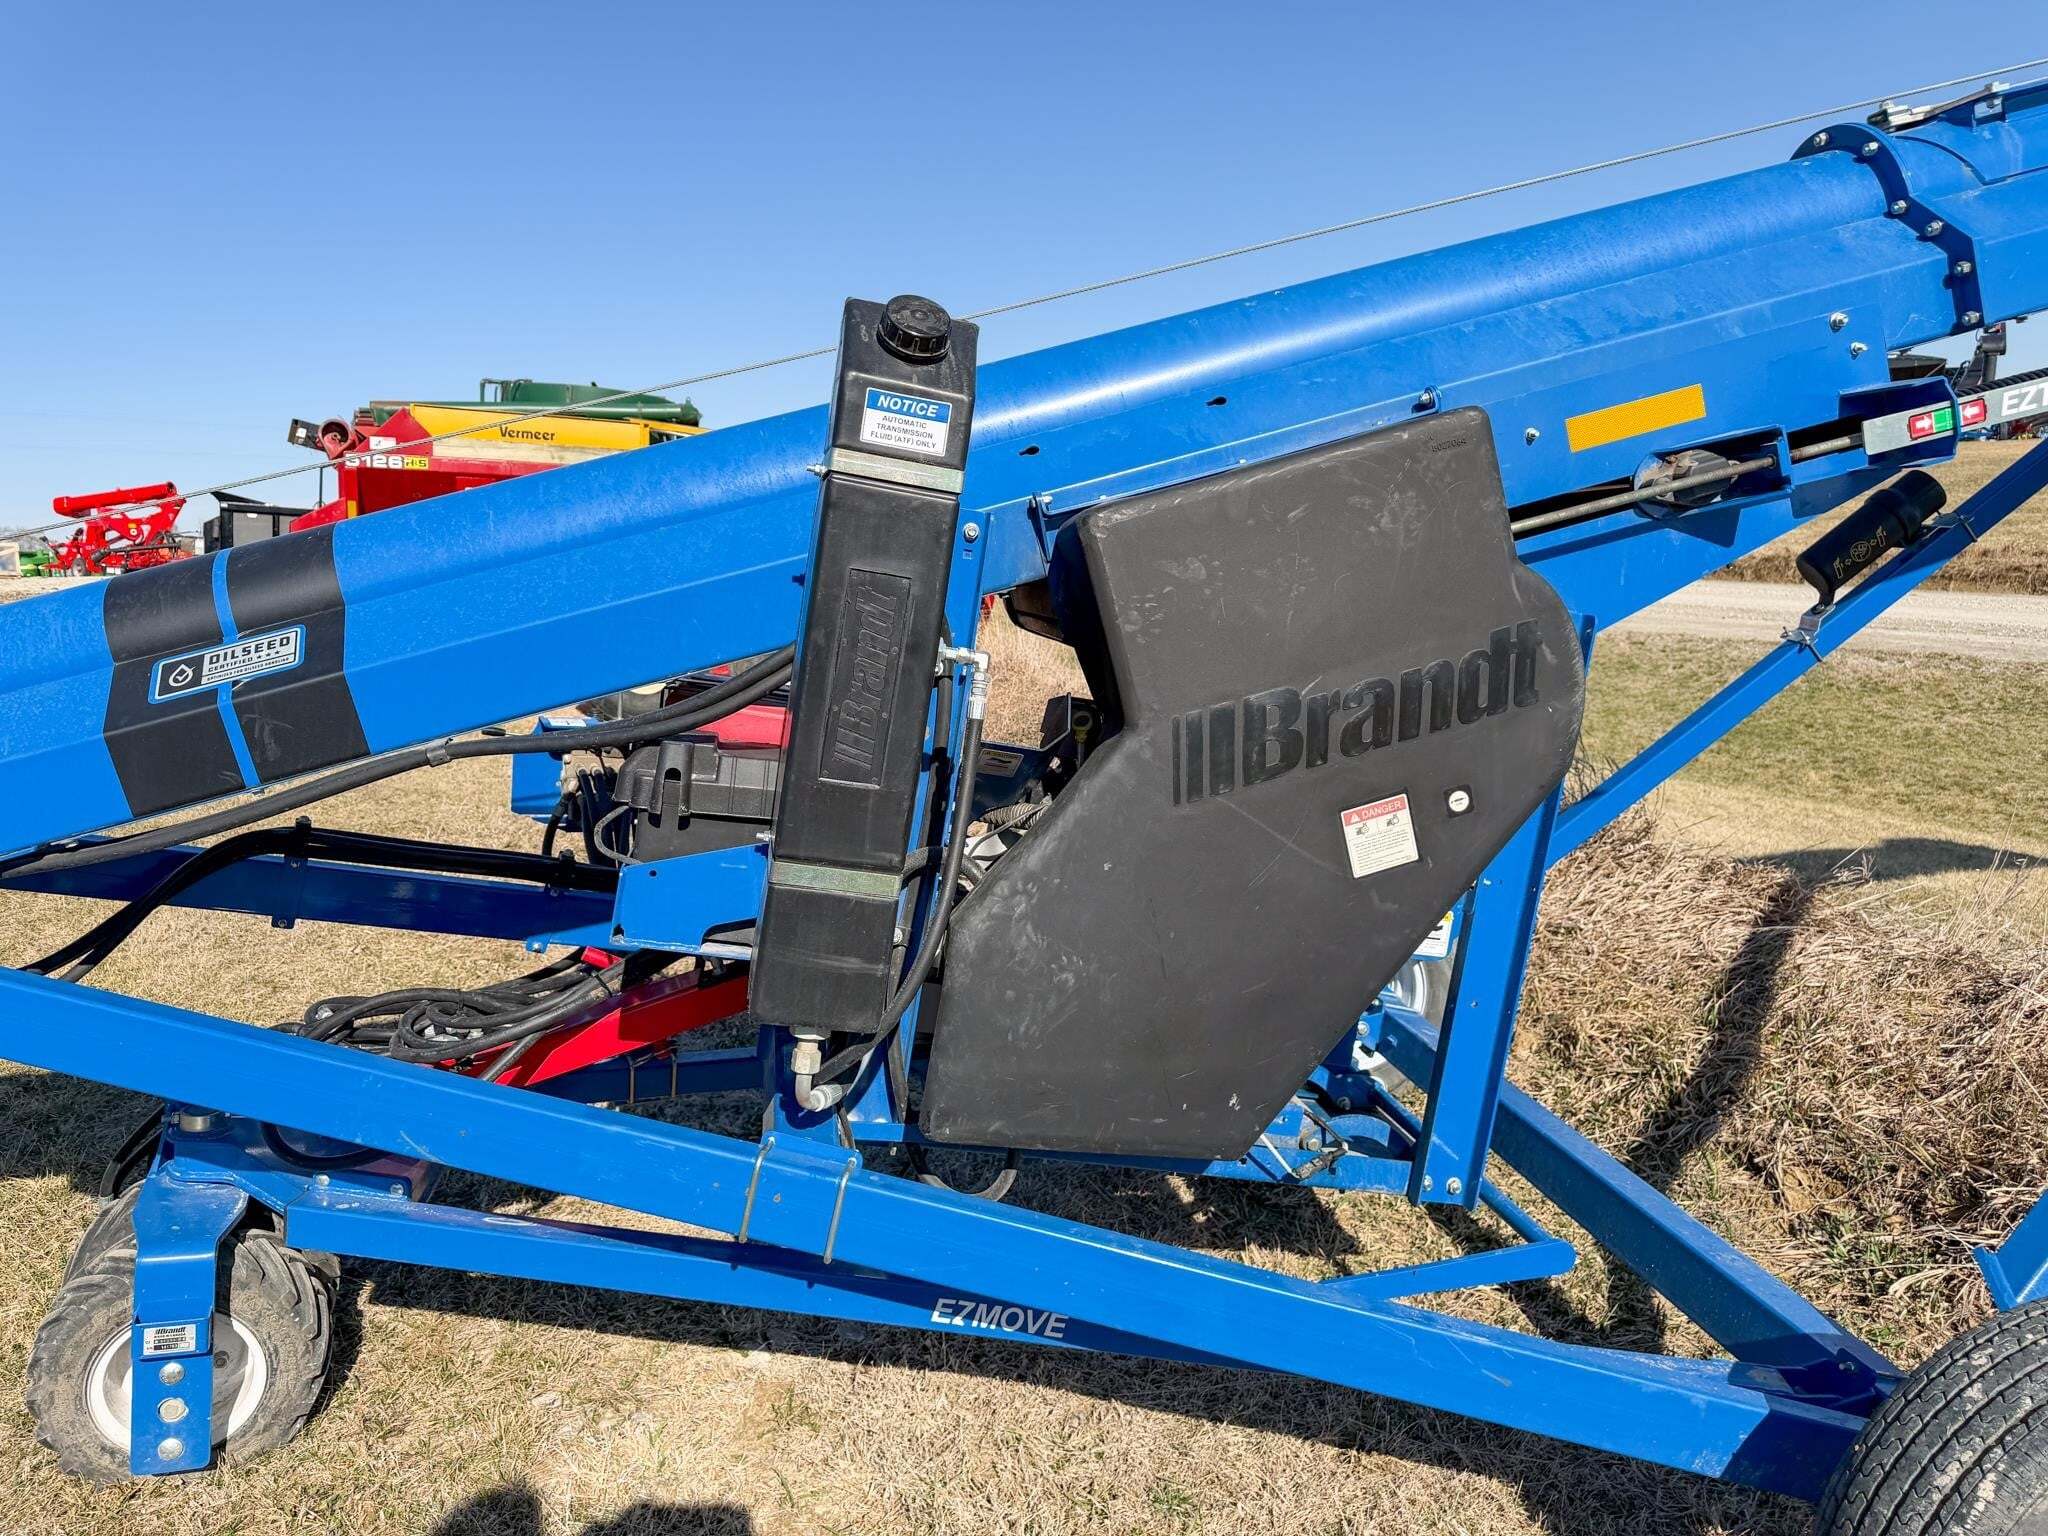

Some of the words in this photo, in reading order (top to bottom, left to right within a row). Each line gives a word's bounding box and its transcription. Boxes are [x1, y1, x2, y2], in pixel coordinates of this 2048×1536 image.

[877, 395, 939, 417] NOTICE
[876, 423, 934, 439] TRANSMISSION
[882, 415, 927, 429] AUTOMATIC
[499, 425, 556, 441] Vermeer
[870, 430, 893, 442] FLUID
[893, 434, 914, 446] (ATF)
[915, 438, 937, 449] ONLY
[344, 452, 404, 469] 3126
[208, 635, 291, 666] OILSEED
[208, 656, 254, 673] CERTIFIED
[838, 585, 897, 739] Brandt
[1242, 618, 1540, 786] Brandt
[1361, 801, 1402, 819] DANGER
[930, 1297, 1070, 1339] EZMOVE
